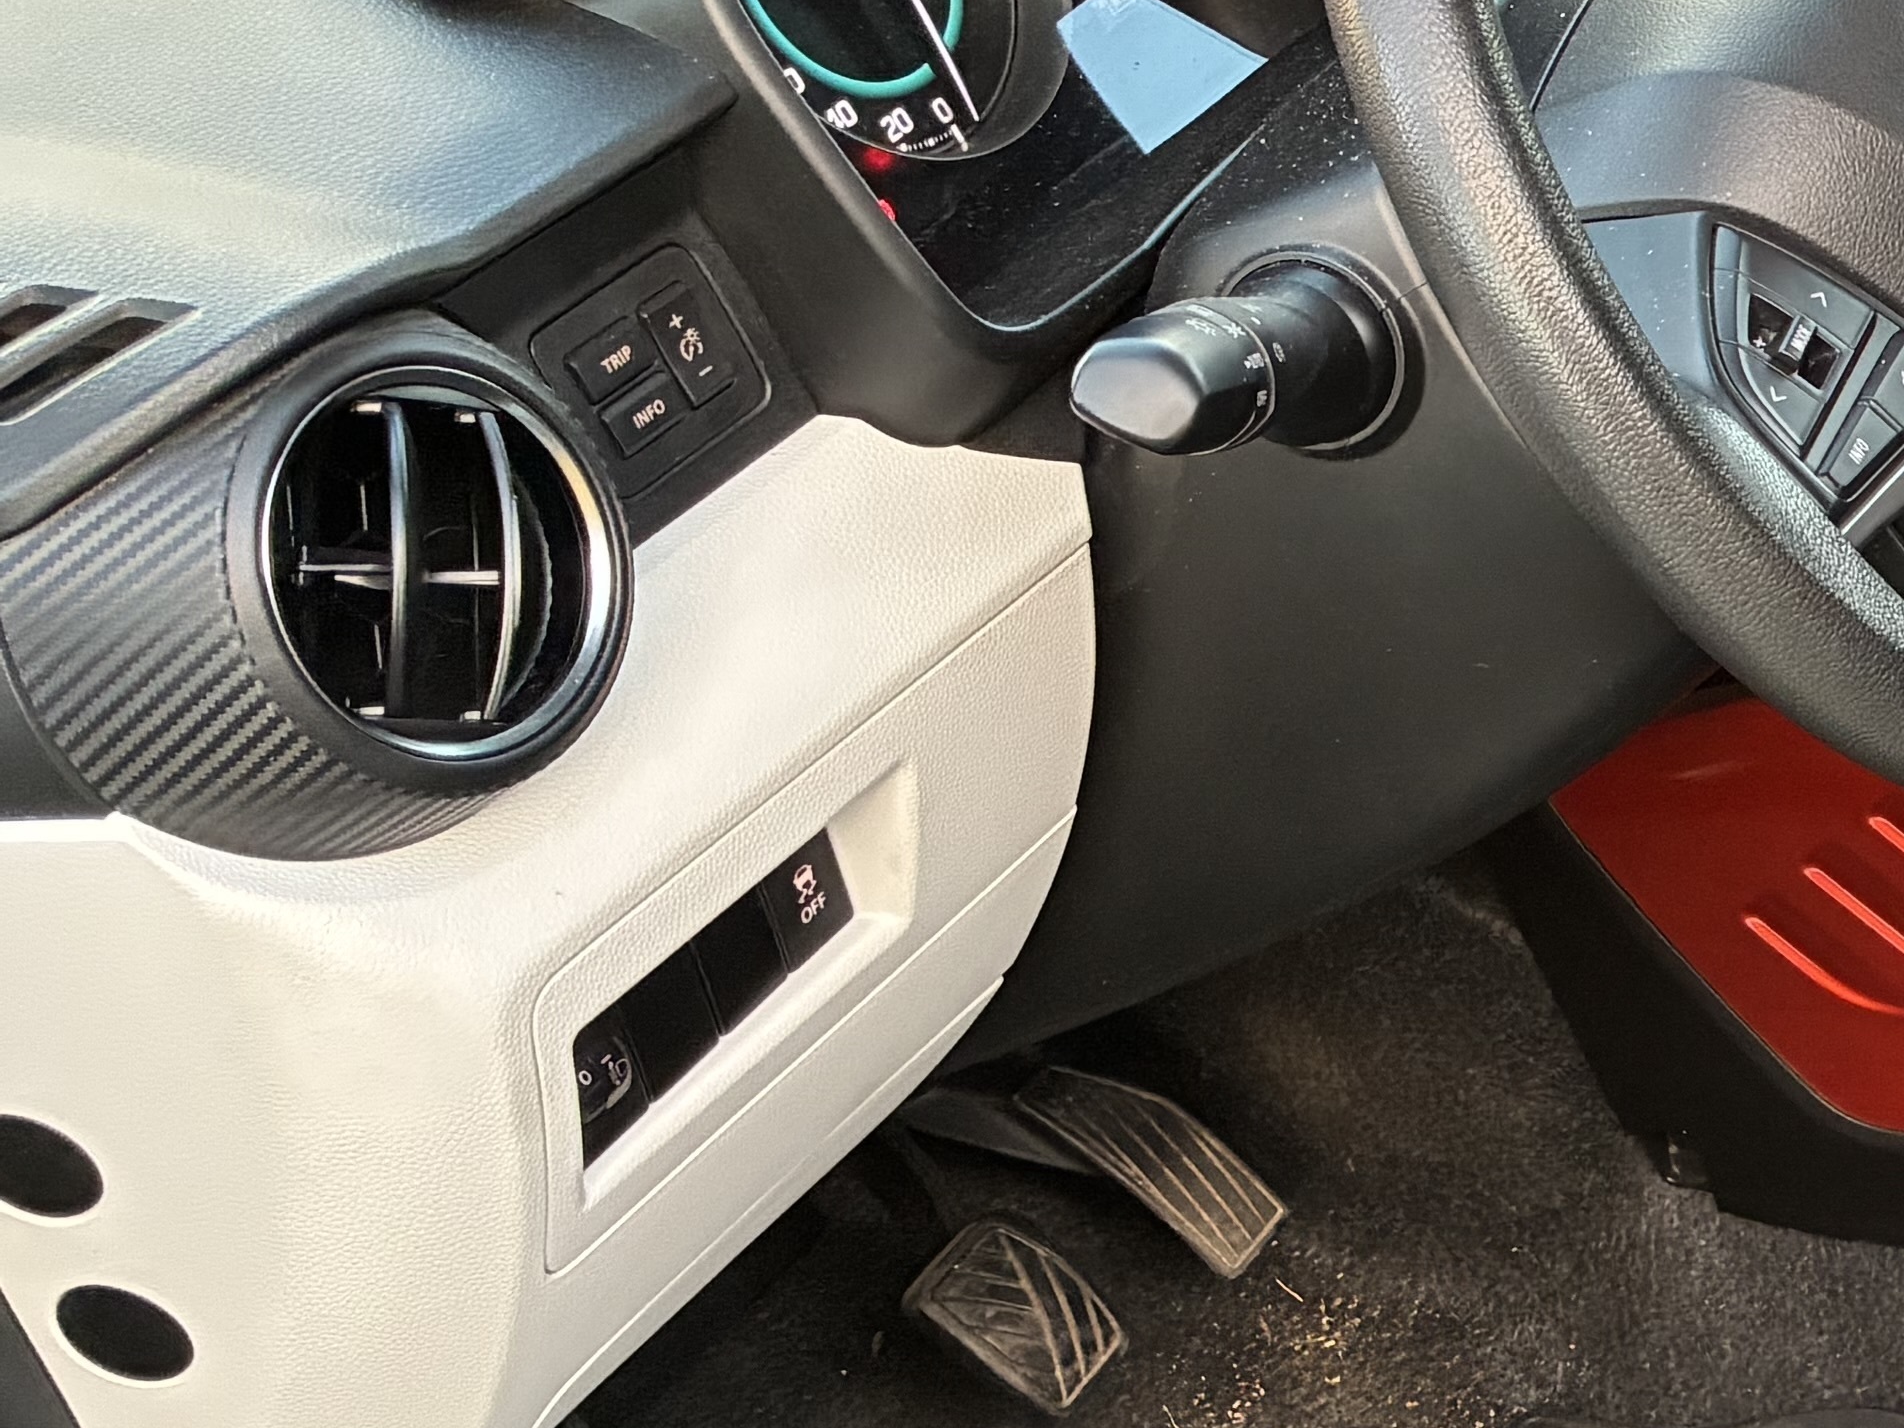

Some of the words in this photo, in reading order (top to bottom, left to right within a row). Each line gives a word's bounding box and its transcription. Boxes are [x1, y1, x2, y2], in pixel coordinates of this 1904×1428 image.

[880, 107, 914, 143] 20
[931, 97, 954, 125] 0
[600, 344, 633, 374] TRIP
[633, 399, 665, 429] INFO
[1848, 438, 1870, 465] INFO
[801, 892, 826, 924] OFF
